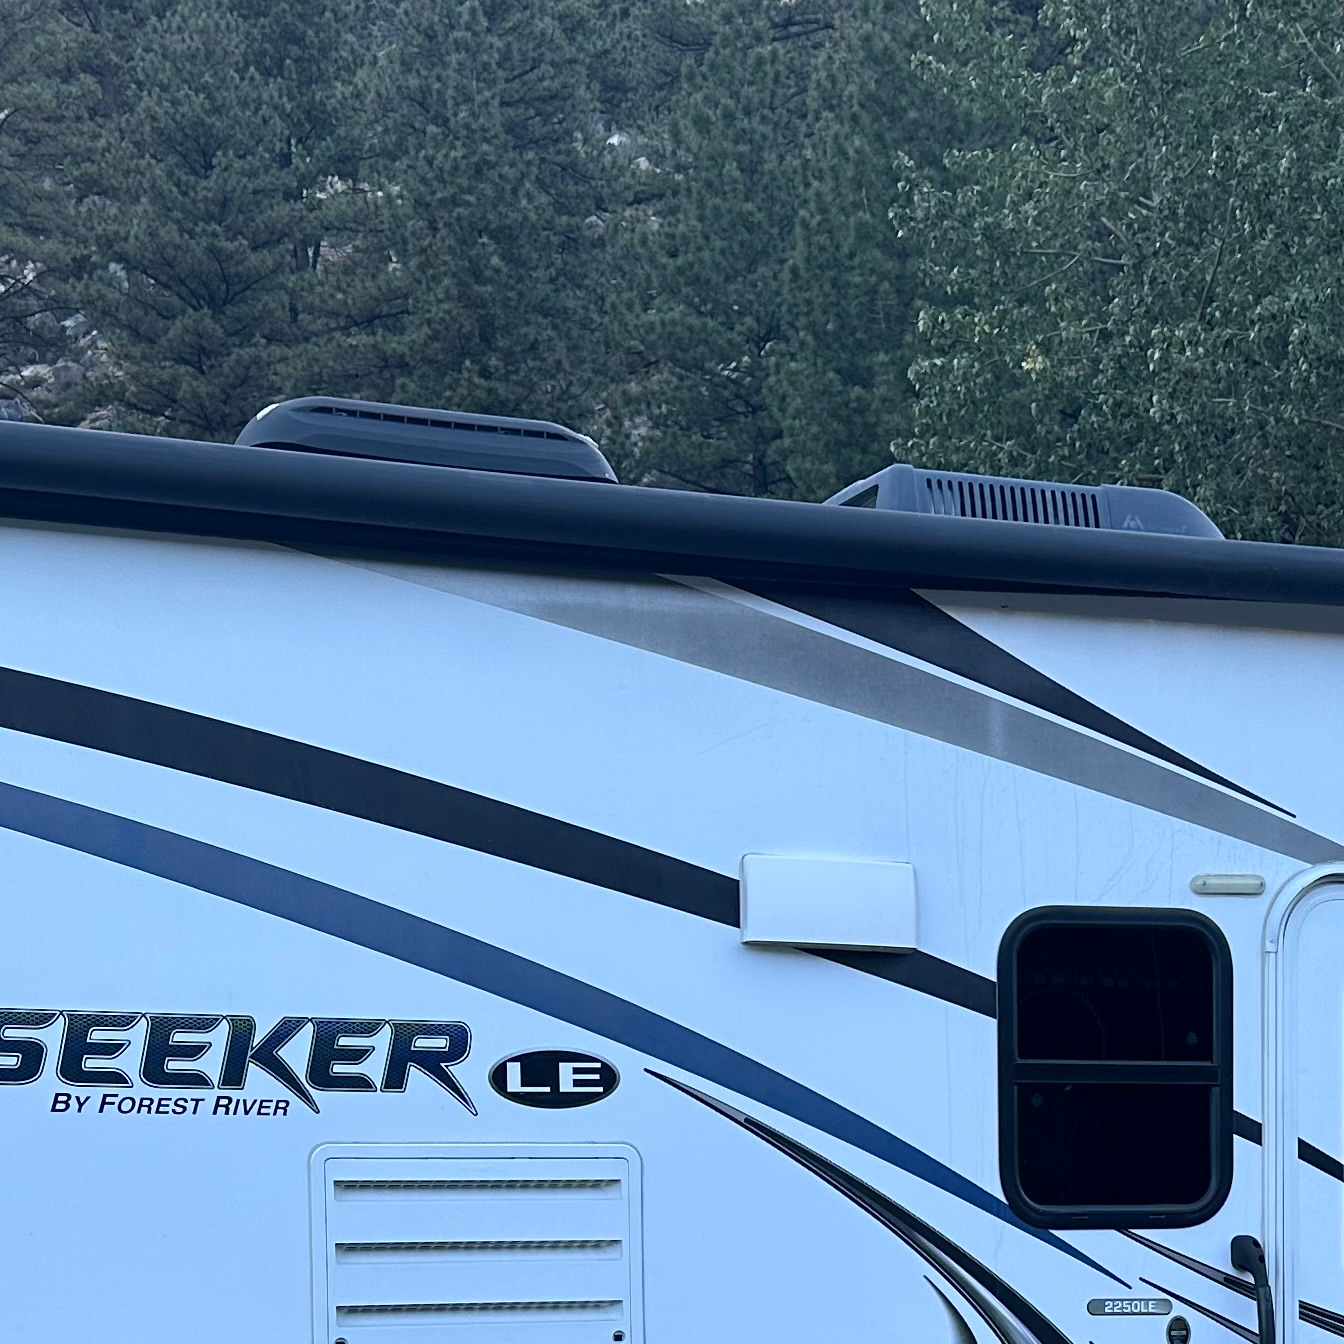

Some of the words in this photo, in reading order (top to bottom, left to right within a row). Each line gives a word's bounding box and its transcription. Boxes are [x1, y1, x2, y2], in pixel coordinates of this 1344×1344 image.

[504, 1061, 610, 1094] LE
[50, 1092, 92, 1114] BY
[98, 1093, 206, 1116] FOREST
[212, 1095, 291, 1117] RIVER
[1104, 1300, 1157, 1313] 2250LE
